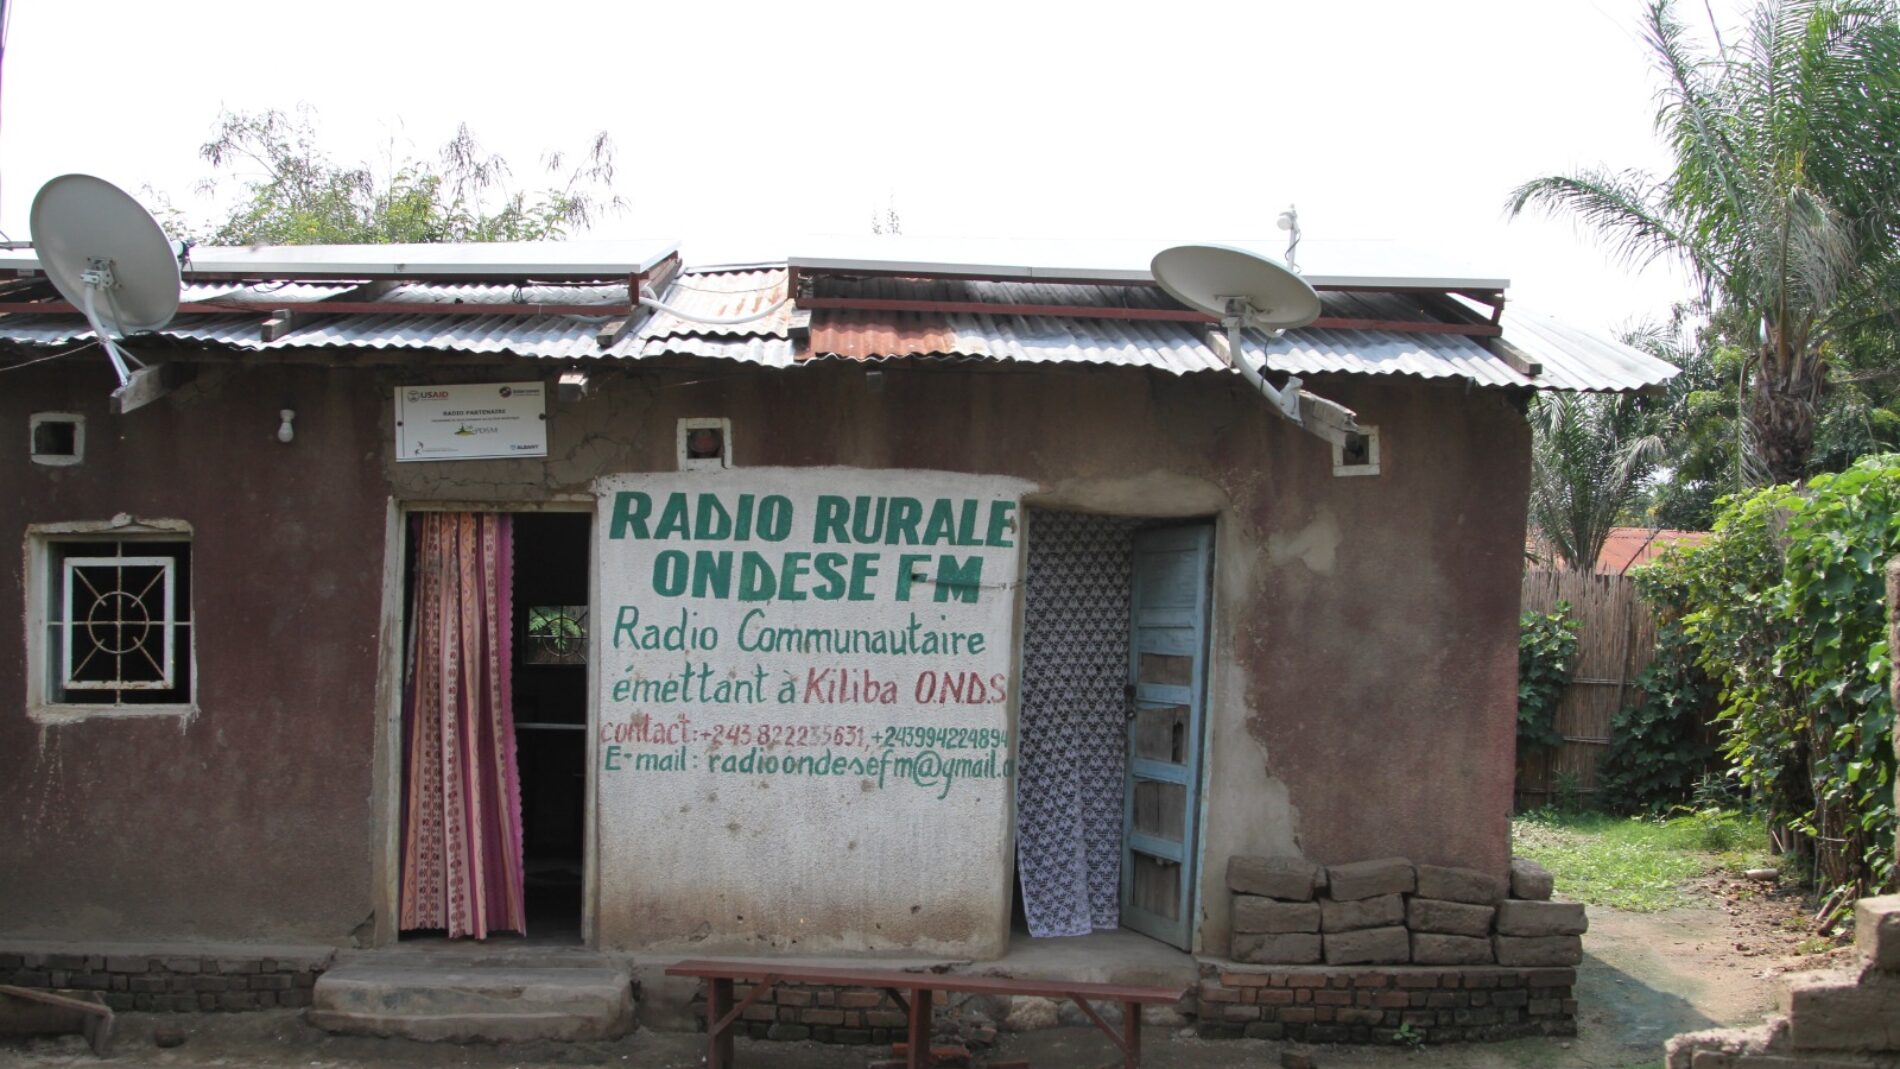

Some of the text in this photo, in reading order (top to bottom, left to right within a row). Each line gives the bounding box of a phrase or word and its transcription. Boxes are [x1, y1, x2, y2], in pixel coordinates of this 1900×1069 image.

[420, 391, 449, 399] USAID
[609, 491, 1017, 548] RADIO RURALE
[651, 549, 984, 603] ONDESE FM
[612, 605, 986, 656] Radio Communautaire
[611, 661, 768, 704] émettant
[804, 666, 897, 705] Kiliba
